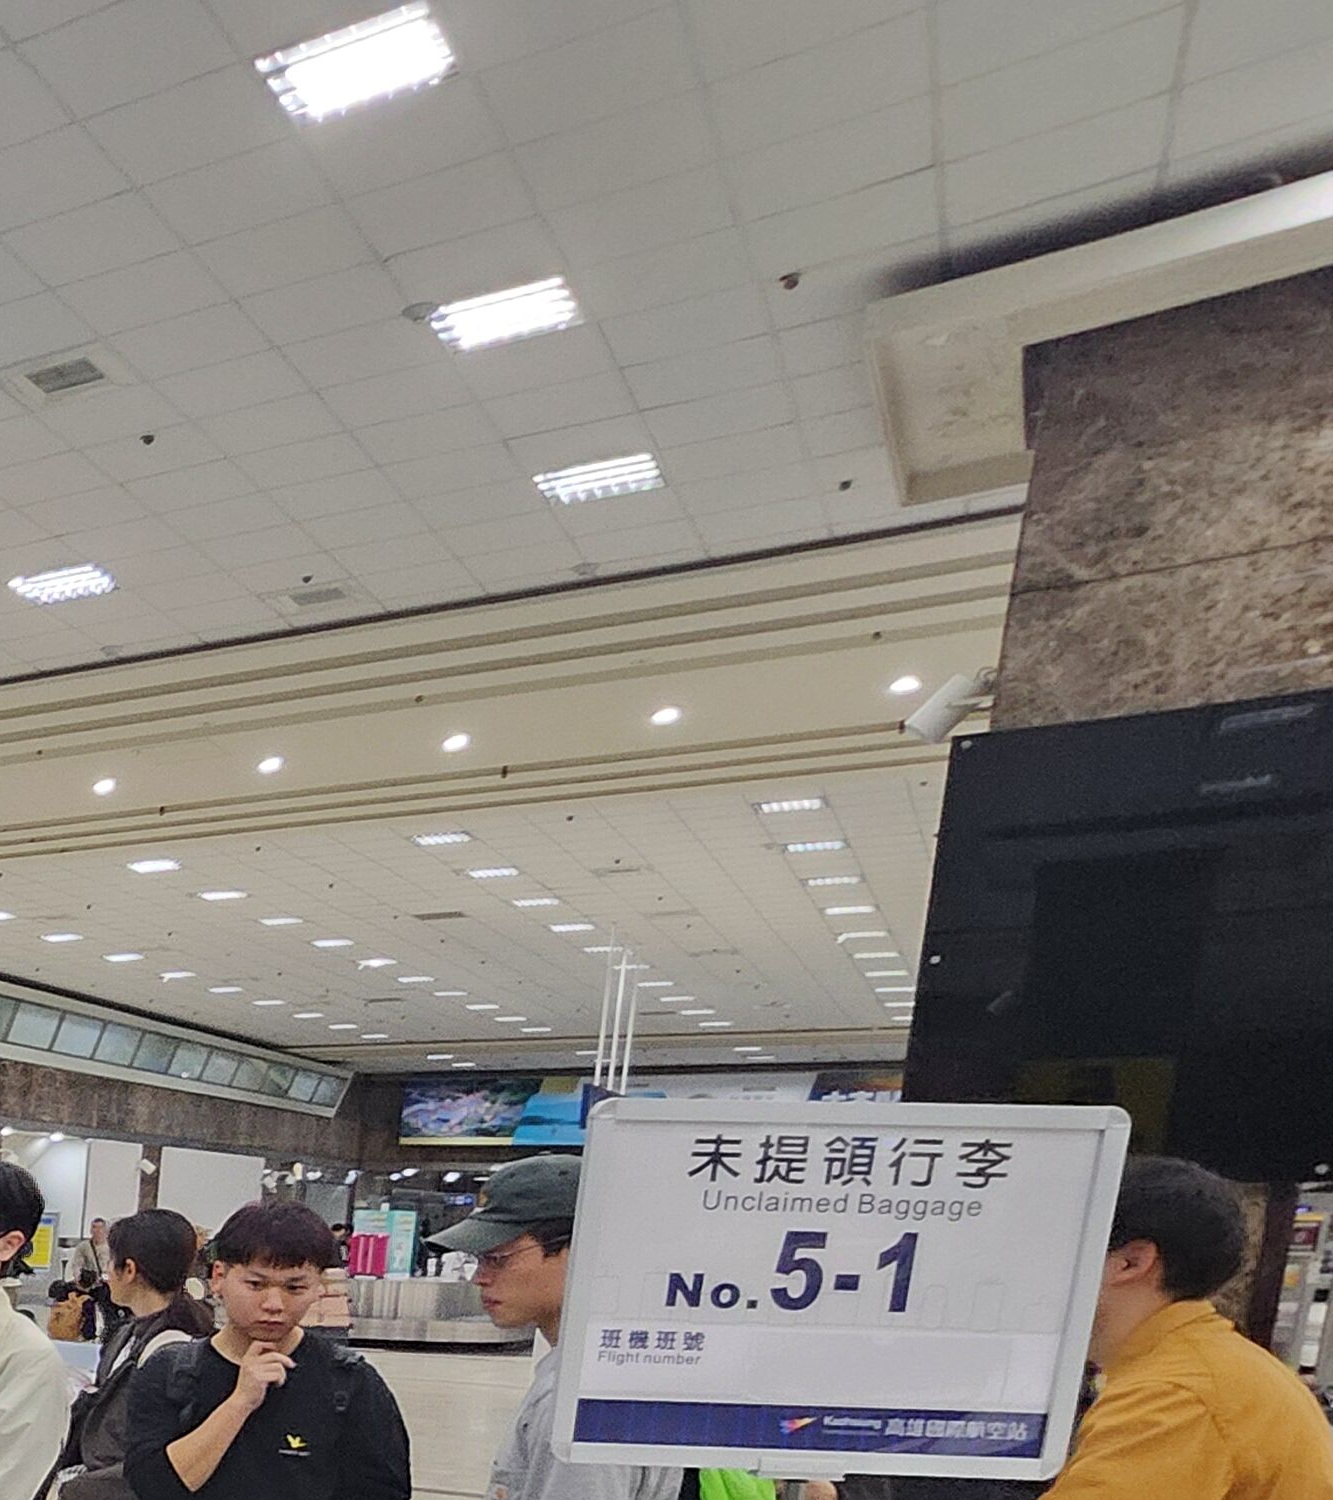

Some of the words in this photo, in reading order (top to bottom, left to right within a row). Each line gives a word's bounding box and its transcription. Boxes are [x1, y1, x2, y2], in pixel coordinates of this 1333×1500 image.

[687, 1133, 1014, 1189] 未提領行李
[701, 1189, 848, 1214] Unclaimed
[858, 1193, 983, 1221] Baggage
[598, 1329, 706, 1351] 班機班號
[597, 1350, 640, 1366] Flight
[643, 1353, 702, 1366] number
